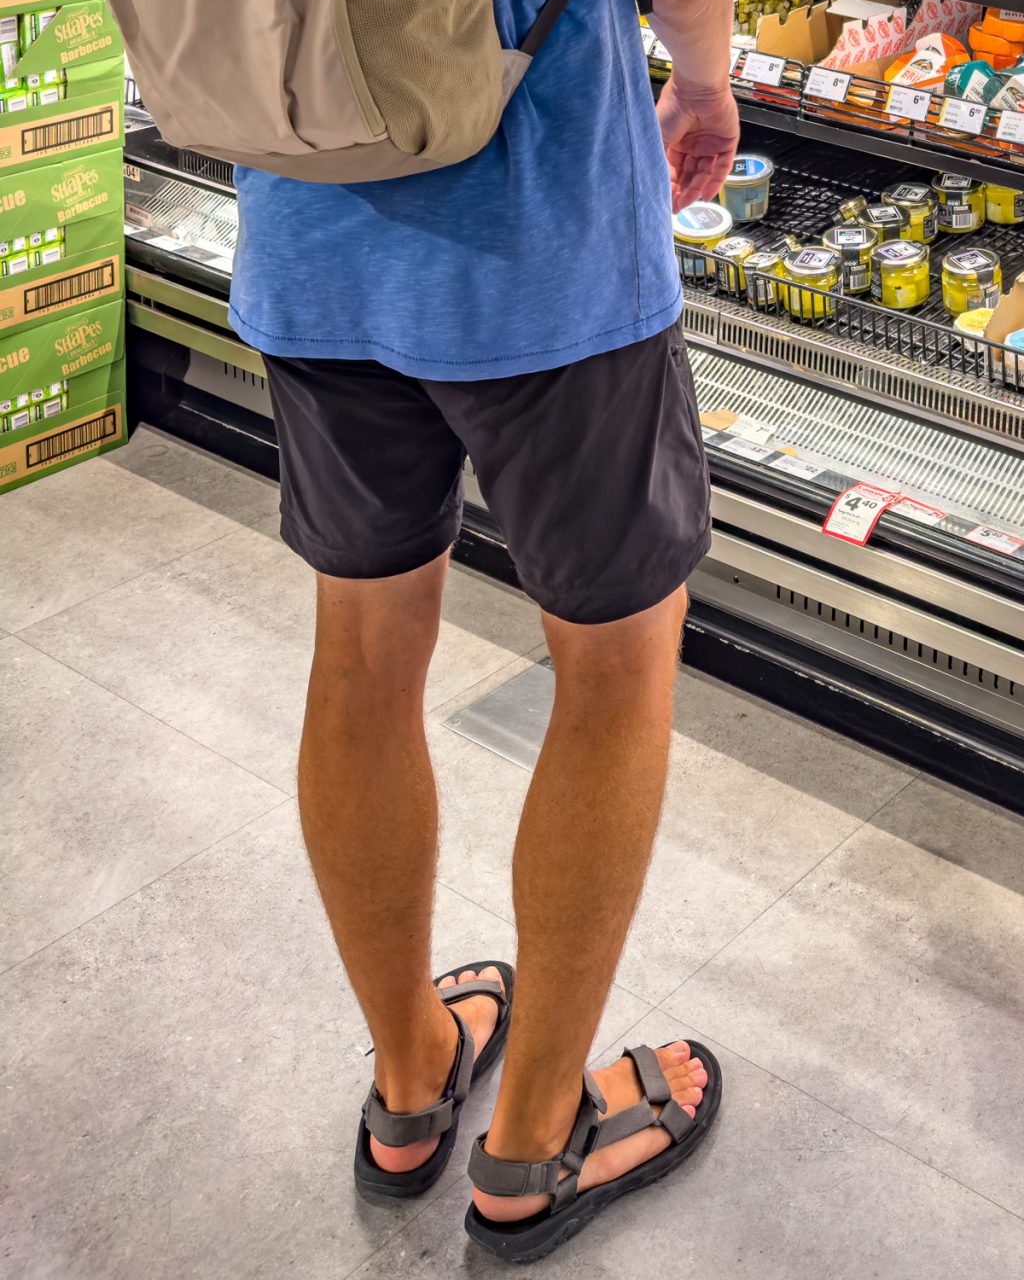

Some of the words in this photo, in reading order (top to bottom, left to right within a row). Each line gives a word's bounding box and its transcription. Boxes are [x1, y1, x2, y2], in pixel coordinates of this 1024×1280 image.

[60, 34, 113, 64] Barbecue
[57, 191, 109, 223] Barbecue
[61, 341, 112, 376] Barbecue
